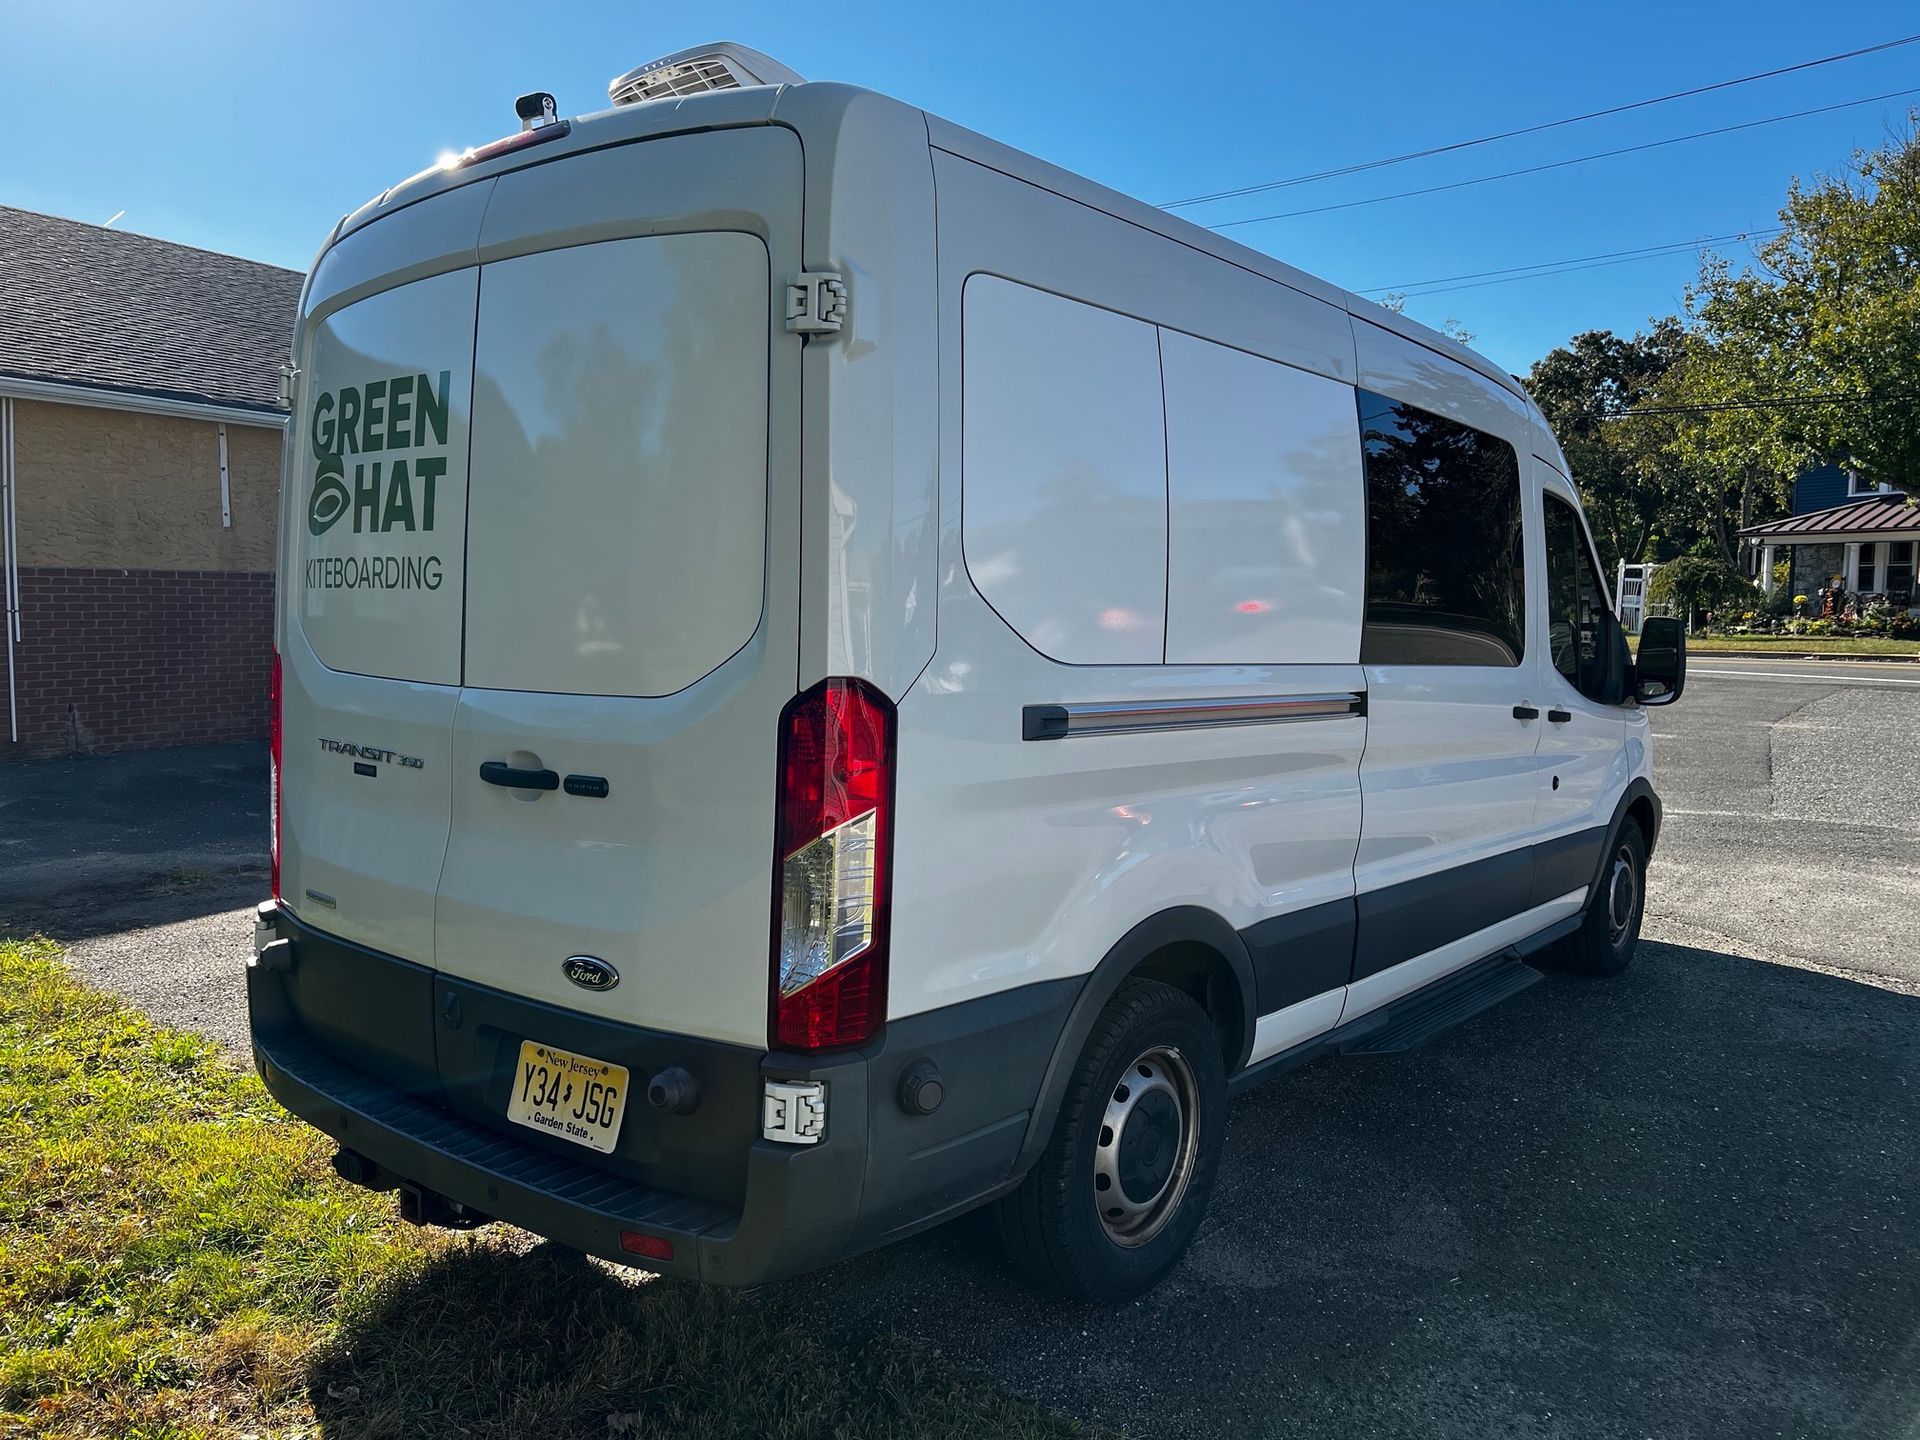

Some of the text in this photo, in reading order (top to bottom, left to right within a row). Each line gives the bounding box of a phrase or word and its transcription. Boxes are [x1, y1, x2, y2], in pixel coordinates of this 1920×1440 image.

[312, 370, 450, 460] GREEN
[353, 457, 447, 534] HAT
[305, 556, 442, 590] KITEBOARDING
[318, 737, 397, 764] TRANSIT
[571, 962, 602, 984] Ford
[545, 1050, 601, 1082] New Jersey
[522, 1062, 618, 1129] Y34 JSG
[534, 1111, 589, 1140] Garden State
